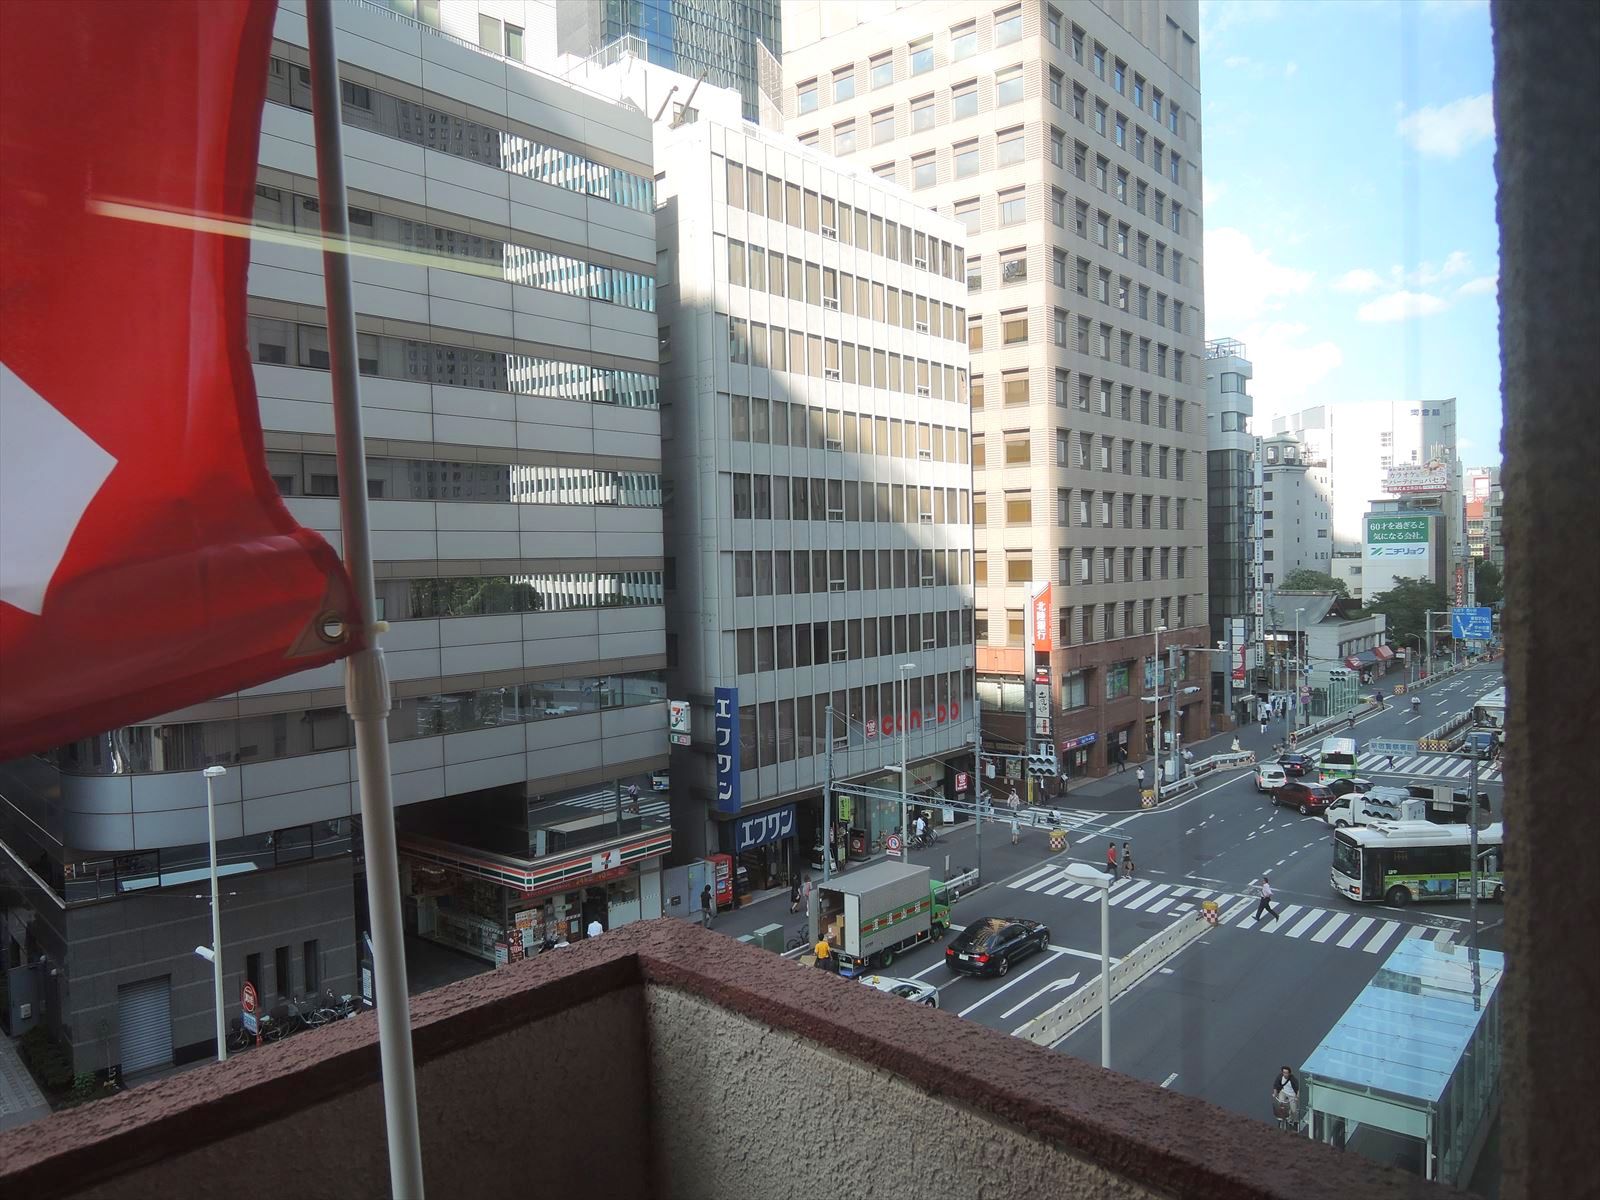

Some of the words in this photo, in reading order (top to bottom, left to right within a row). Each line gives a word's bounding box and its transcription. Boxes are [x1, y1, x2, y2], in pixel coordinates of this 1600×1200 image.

[1370, 521, 1425, 530] 60才を過ぎると
[1373, 531, 1424, 540] 気になる会社。
[1385, 547, 1425, 555] ニチリョク
[1036, 601, 1047, 640] 北陸銀行
[716, 699, 732, 800] エフワン
[740, 809, 793, 849] エフワン
